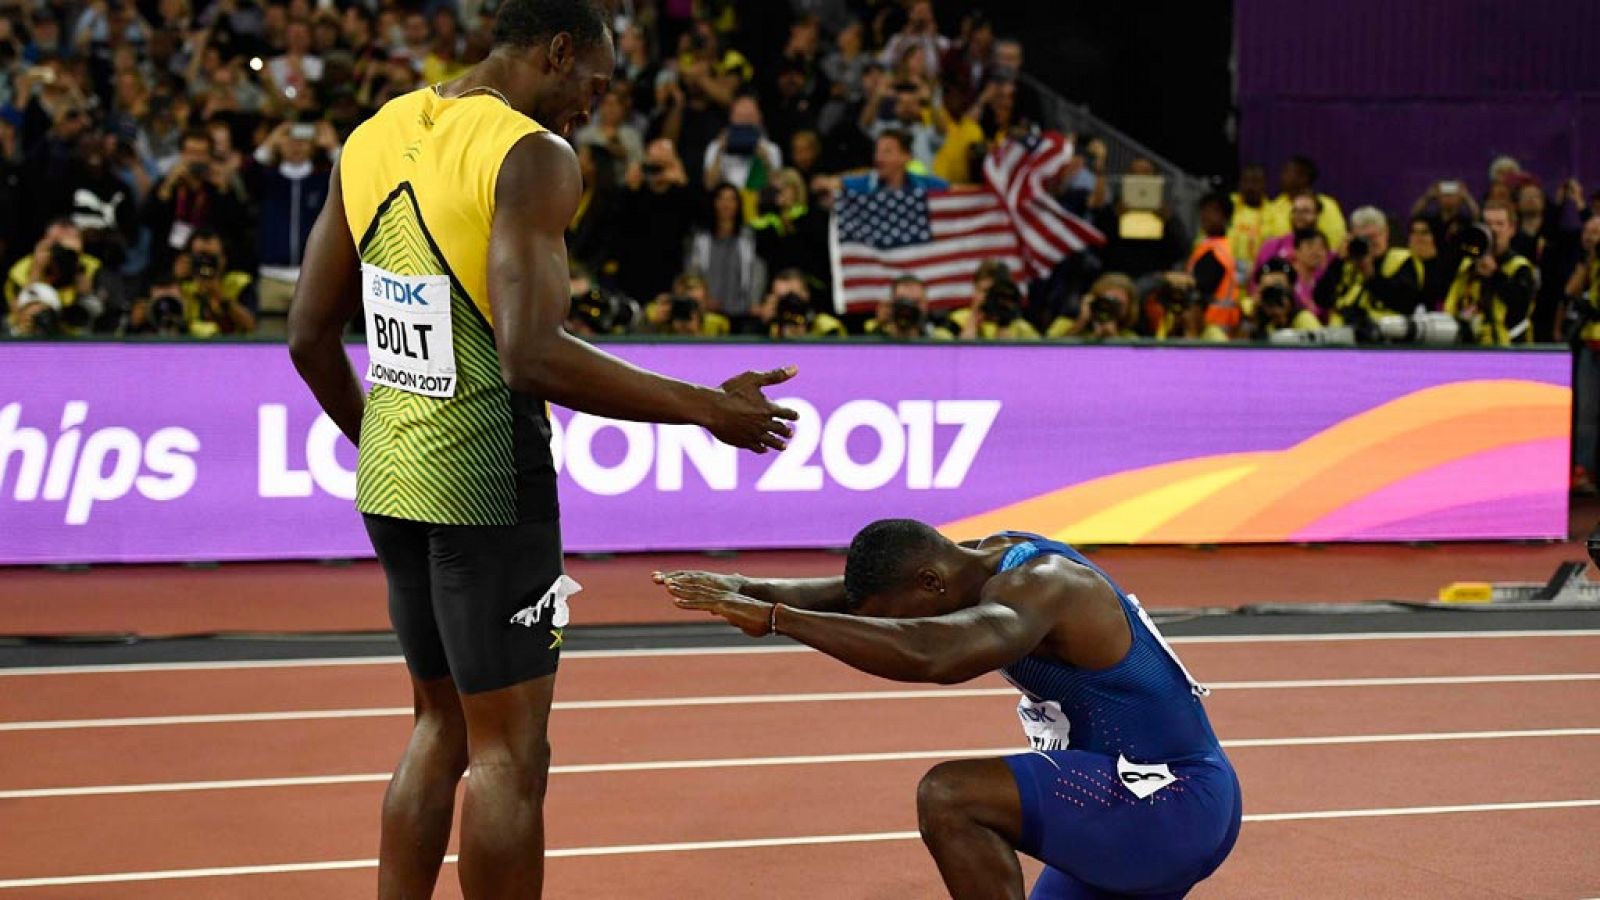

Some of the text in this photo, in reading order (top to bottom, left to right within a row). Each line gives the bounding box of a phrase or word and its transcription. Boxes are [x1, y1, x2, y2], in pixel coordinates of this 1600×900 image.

[381, 277, 429, 306] TDK
[374, 313, 433, 360] BOLT
[371, 362, 453, 392] LONDON 2017
[0, 400, 200, 525] hips
[755, 396, 1001, 492] 2017
